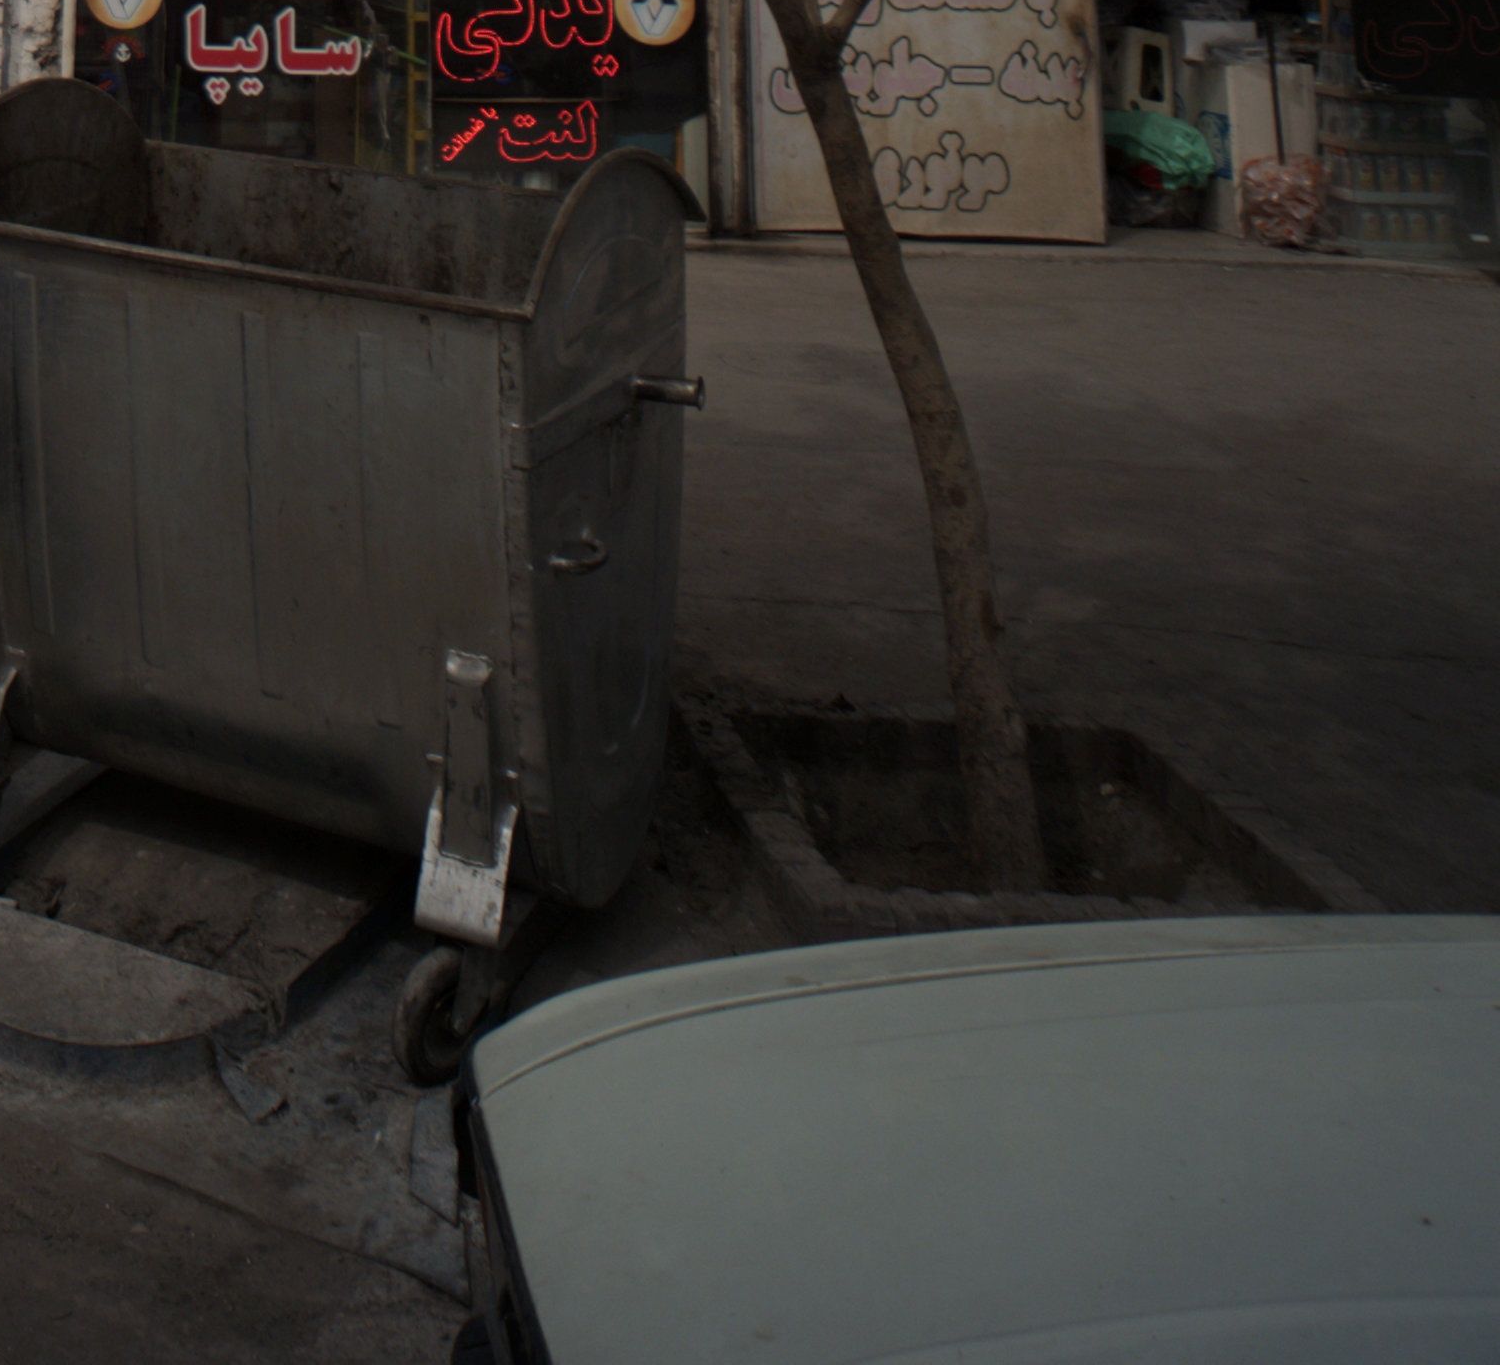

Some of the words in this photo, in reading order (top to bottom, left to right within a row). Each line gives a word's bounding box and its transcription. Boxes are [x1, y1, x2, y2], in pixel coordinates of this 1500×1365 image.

[185, 2, 363, 106] سایپا
[770, 35, 948, 118] جلوبنی
[497, 99, 600, 164] لنت
